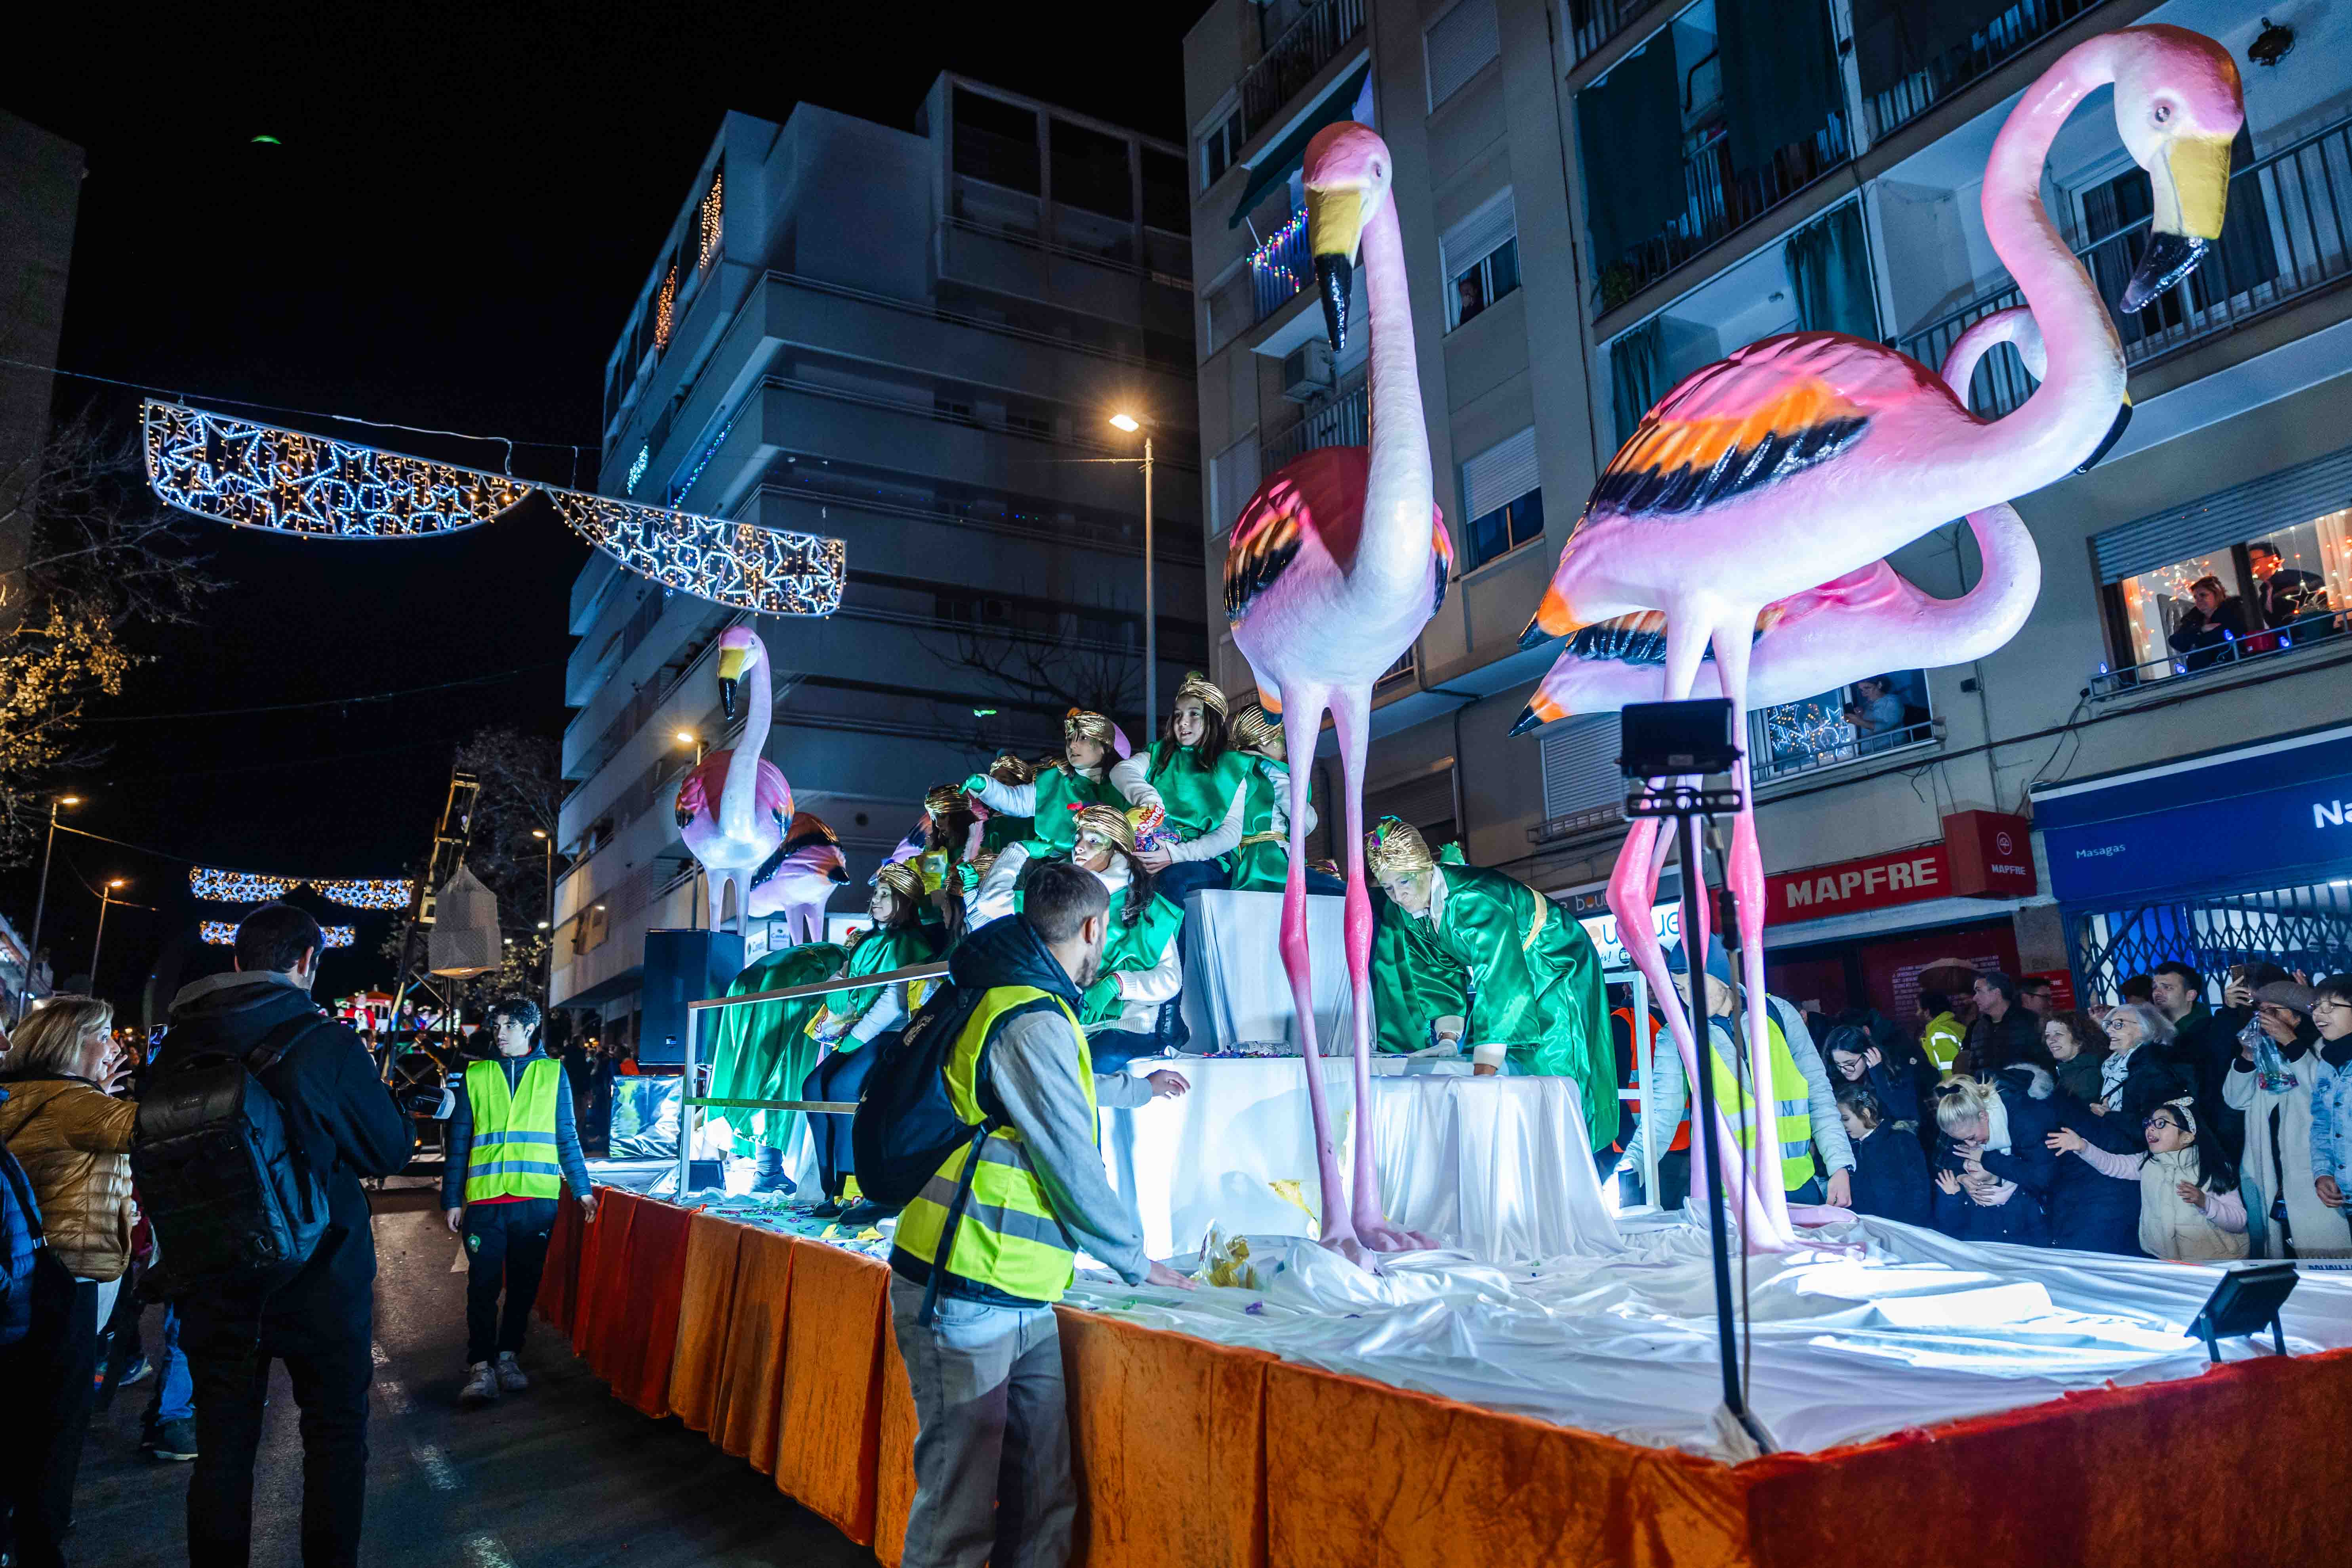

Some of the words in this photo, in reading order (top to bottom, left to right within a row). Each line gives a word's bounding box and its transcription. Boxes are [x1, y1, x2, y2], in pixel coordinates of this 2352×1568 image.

[1138, 805, 1164, 832] Dame
[2076, 844, 2126, 859] Masagas
[1991, 864, 2027, 875] MAPFRE
[1786, 857, 1938, 908] MAPFRE
